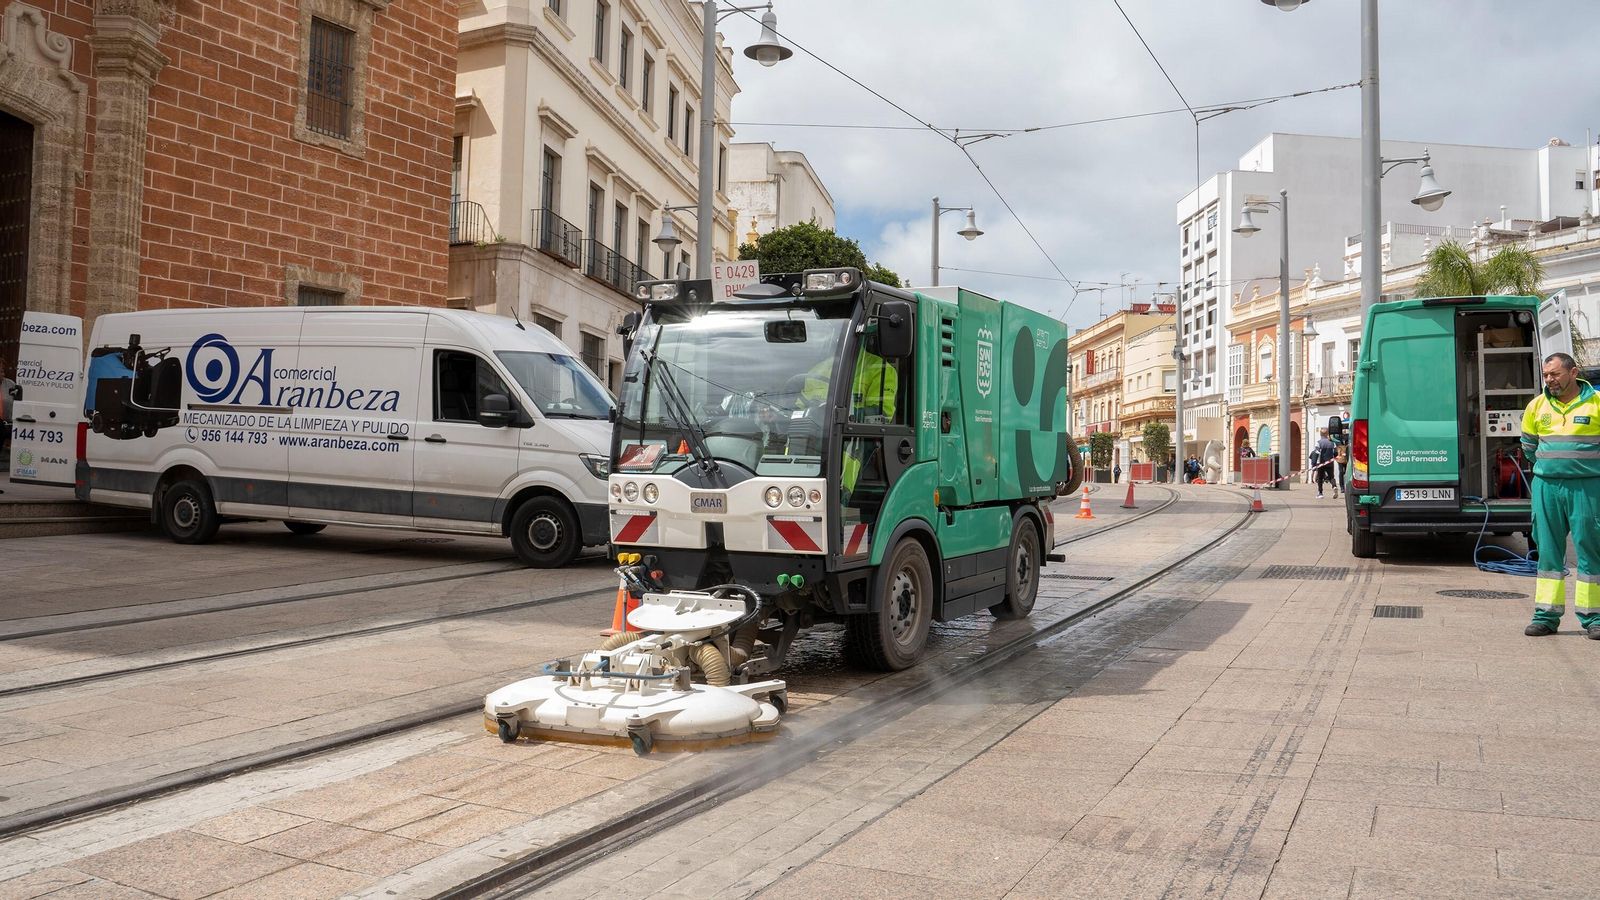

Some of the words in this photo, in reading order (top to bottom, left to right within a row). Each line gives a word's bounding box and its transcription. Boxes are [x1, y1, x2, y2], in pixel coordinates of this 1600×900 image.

[714, 266, 722, 279] E
[726, 264, 755, 279] 0429
[22, 321, 77, 336] beza.com
[17, 366, 74, 381] anbeza
[229, 348, 401, 412] Aranbeza
[273, 366, 337, 381] comercial
[51, 382, 74, 390] PULIDO
[183, 412, 256, 427] MECANIZADO
[258, 415, 275, 428] DE
[277, 416, 292, 429] LA
[294, 417, 349, 432] LIMPIEZA
[351, 420, 360, 433] Y
[362, 420, 410, 436] PULIDO
[13, 427, 35, 441] 144
[39, 429, 63, 443] 793
[201, 429, 221, 442] 956
[225, 430, 244, 444] 144
[248, 431, 268, 445] 793
[278, 436, 400, 453] www.aranbeza.com
[40, 456, 68, 465] MAN
[1403, 489, 1428, 499] 3519
[1432, 489, 1451, 499] LNN
[693, 497, 723, 508] CMAR
